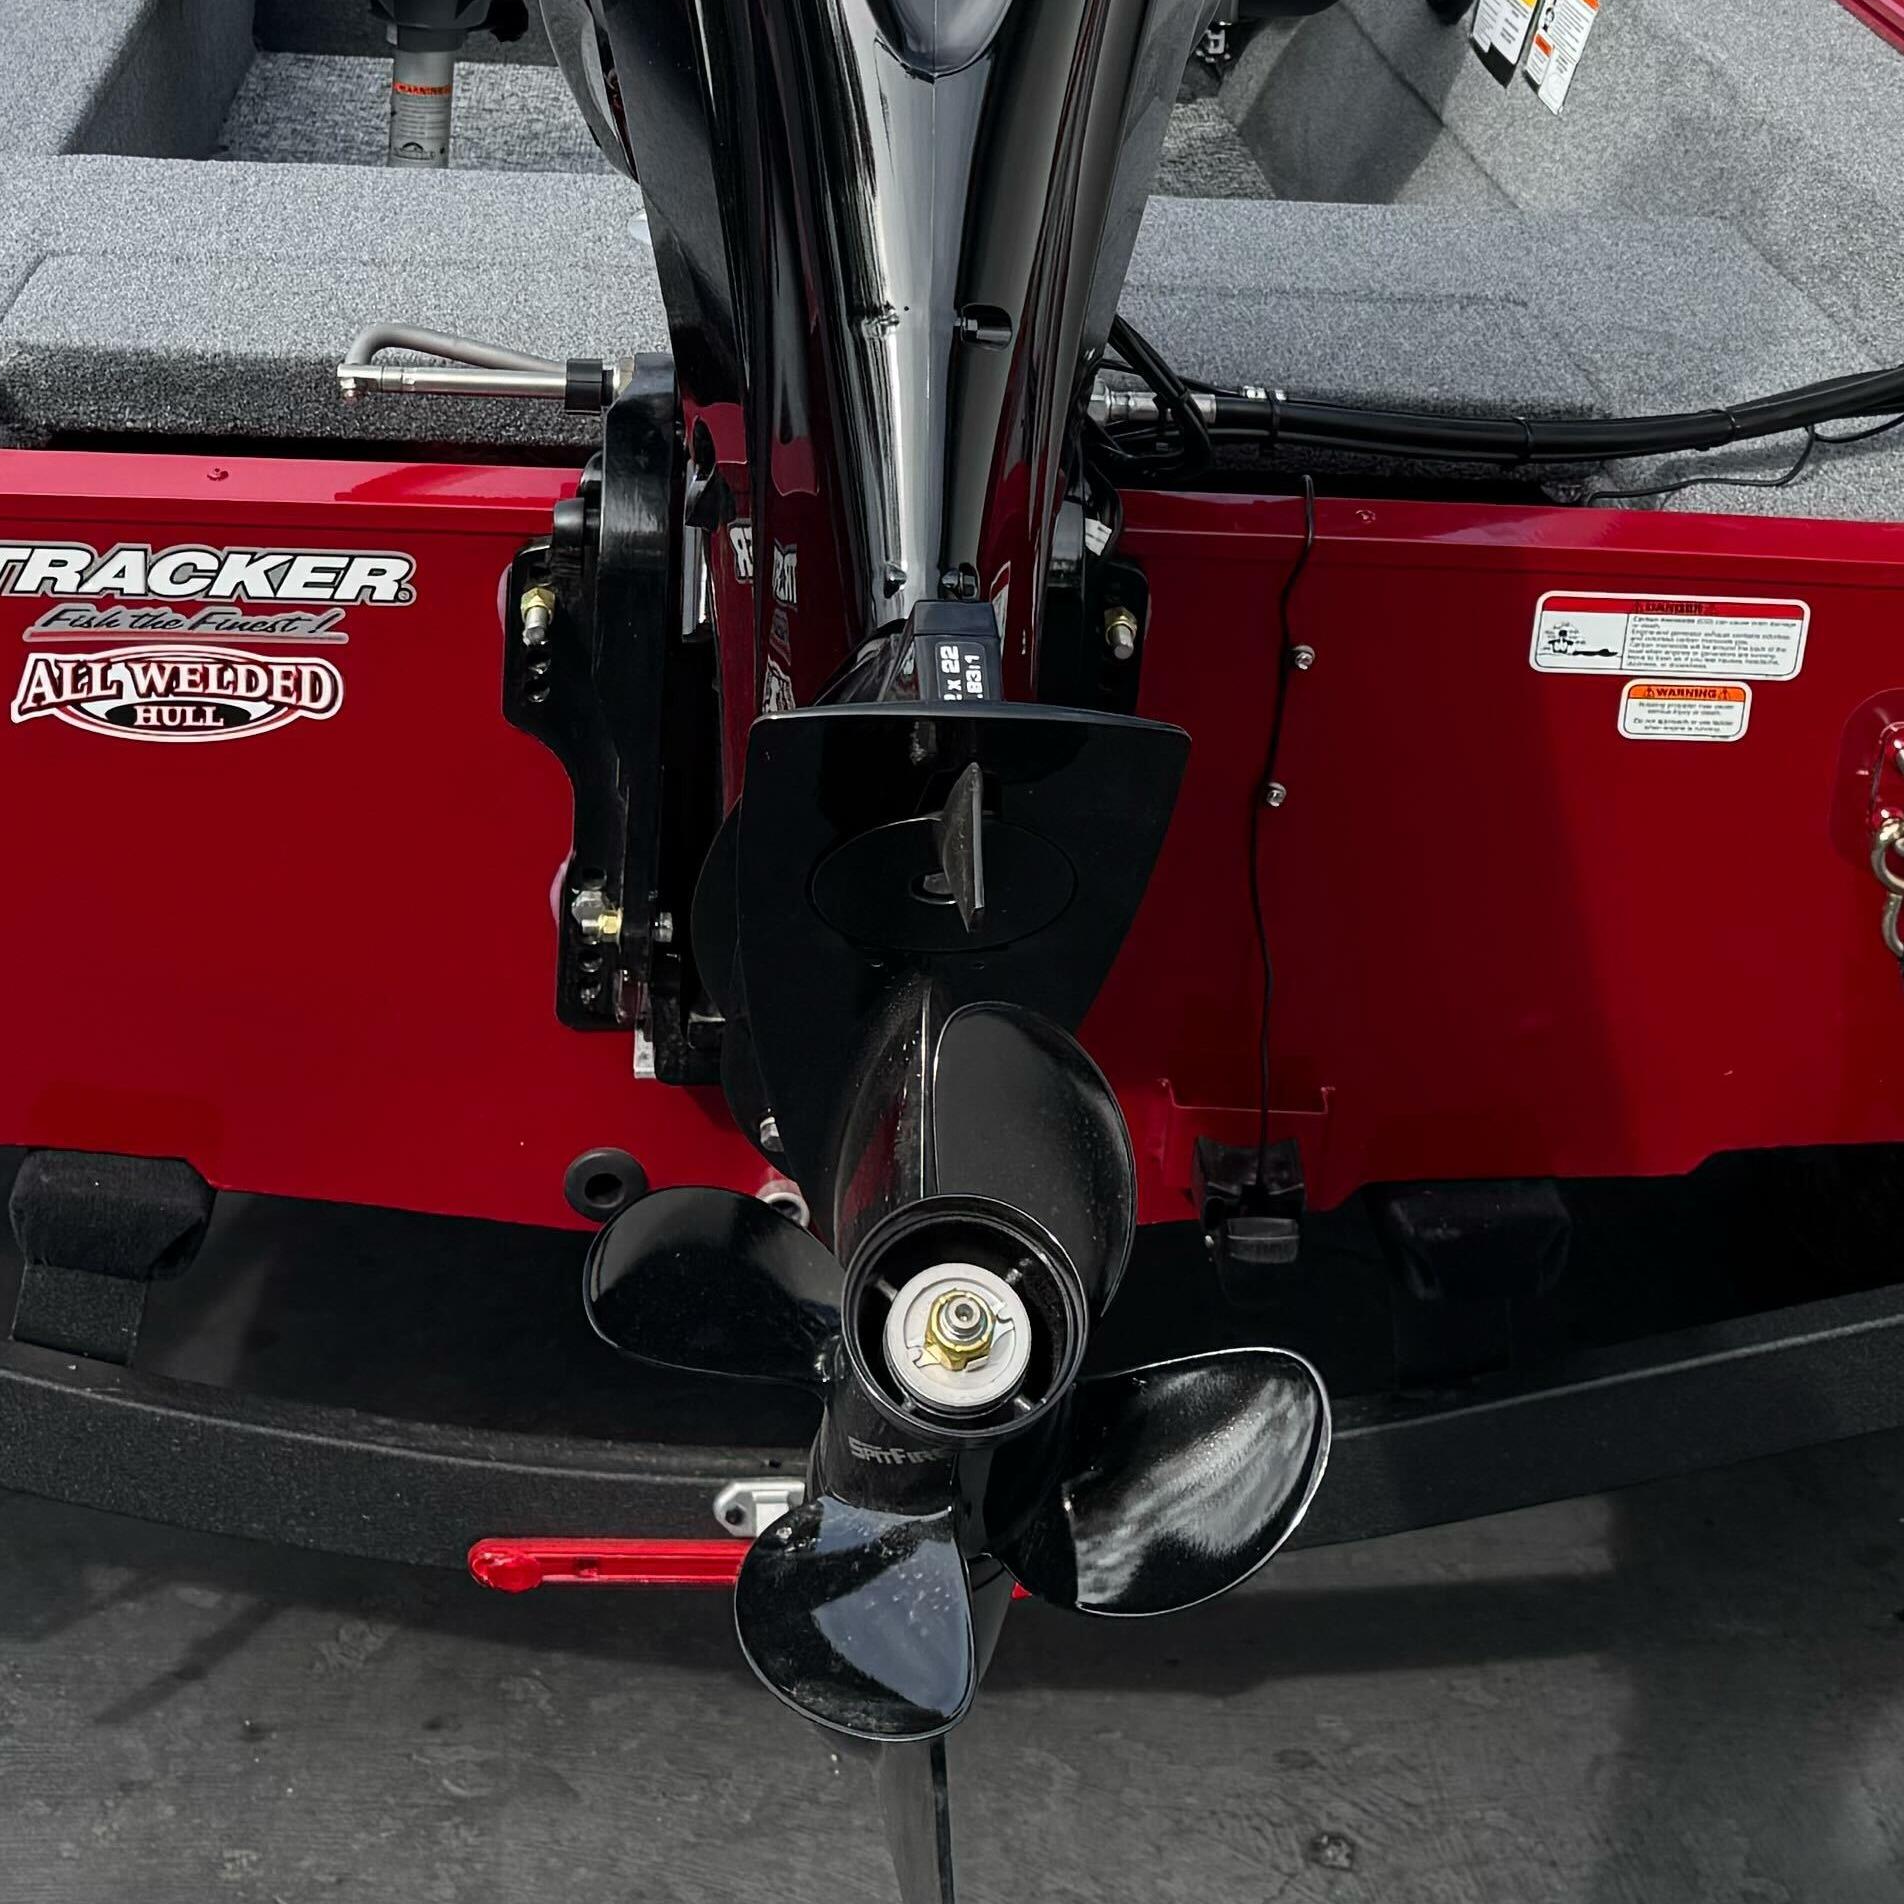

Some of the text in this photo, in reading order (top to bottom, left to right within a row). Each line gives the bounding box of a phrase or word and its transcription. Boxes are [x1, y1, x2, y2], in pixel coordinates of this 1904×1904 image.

[41, 607, 121, 628] Fish
[128, 609, 186, 629] the
[940, 646, 960, 674] 22
[18, 658, 334, 713] ALL WELDED
[1656, 687, 1717, 698] WARNING
[133, 705, 225, 728] HULL
